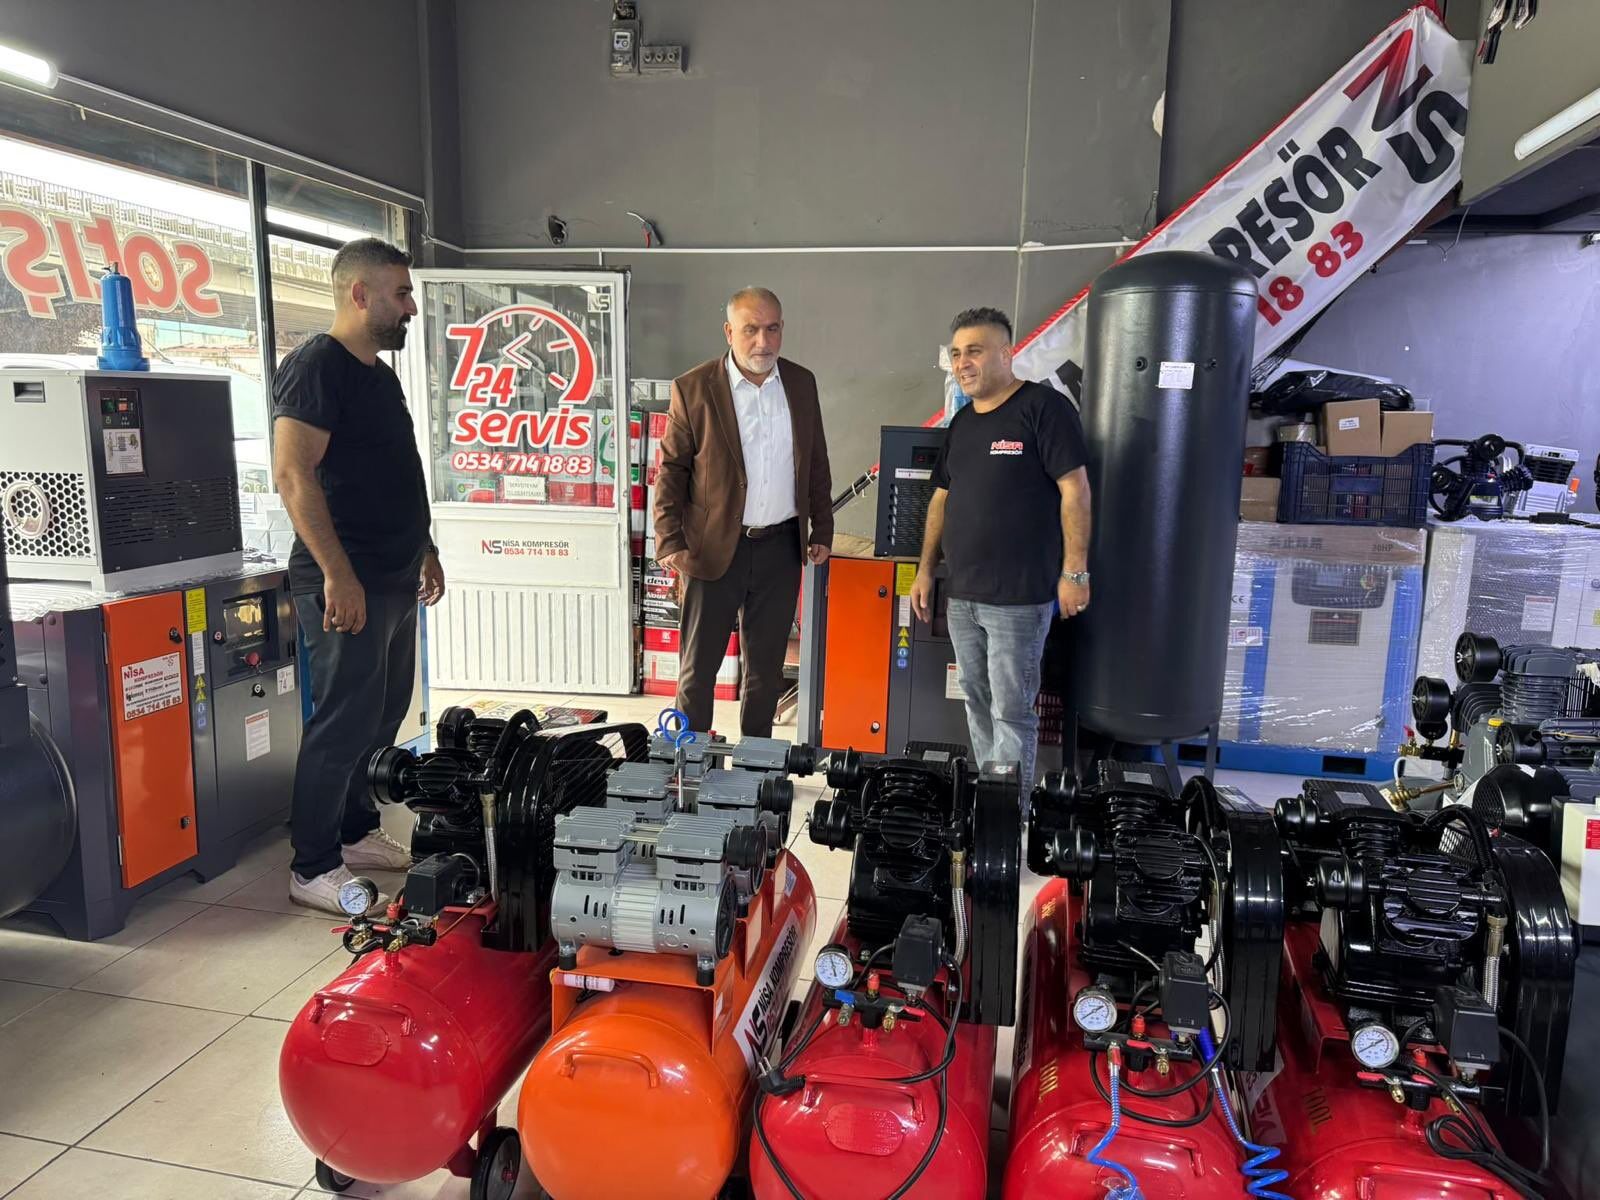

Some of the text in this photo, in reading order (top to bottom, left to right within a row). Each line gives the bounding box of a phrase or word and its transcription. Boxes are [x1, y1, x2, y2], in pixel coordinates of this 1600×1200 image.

[1208, 126, 1383, 279] RESÖR
[1307, 221, 1364, 278] 83
[448, 327, 487, 387] 7
[468, 365, 515, 404] 24
[454, 407, 591, 447] servis
[453, 452, 593, 475] 0534 714 18 83
[502, 539, 569, 549] NİSA KOMPRESÖR
[528, 548, 543, 556] 714
